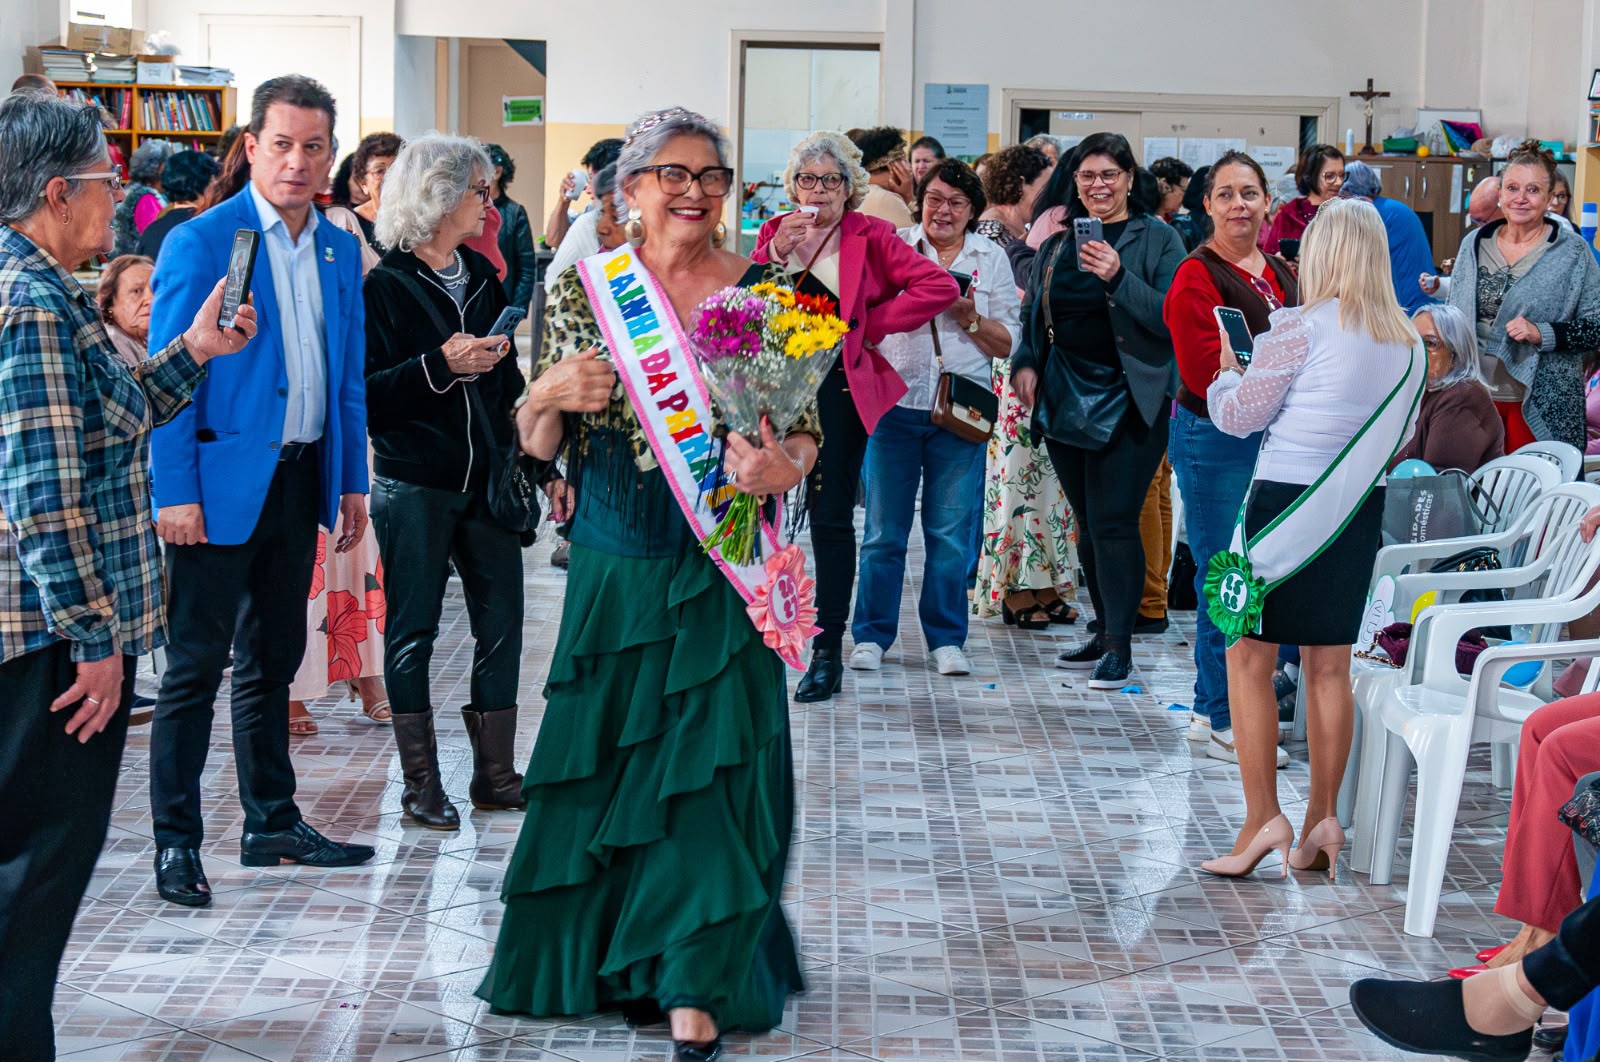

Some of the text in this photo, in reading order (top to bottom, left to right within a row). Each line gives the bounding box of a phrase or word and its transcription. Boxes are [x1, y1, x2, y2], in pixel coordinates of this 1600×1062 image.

[603, 252, 661, 356] RAINHA
[640, 348, 679, 396] DA
[1410, 490, 1427, 543] LIDADES
[1420, 493, 1434, 542] omésticas
